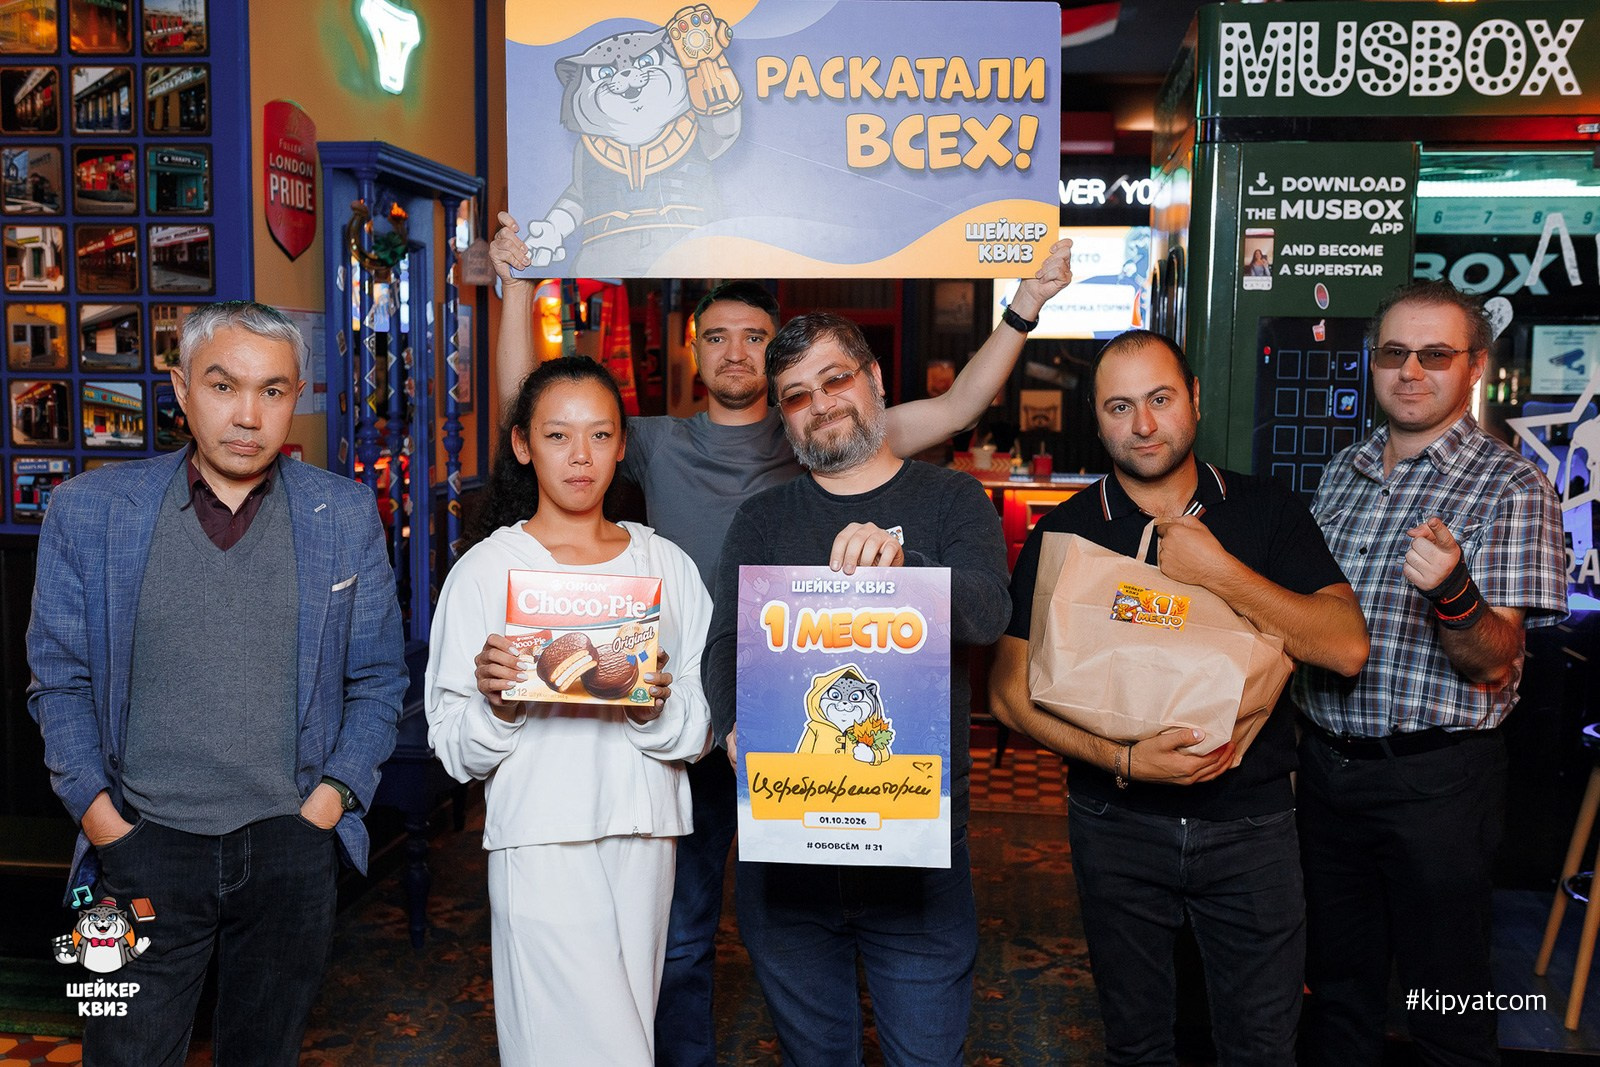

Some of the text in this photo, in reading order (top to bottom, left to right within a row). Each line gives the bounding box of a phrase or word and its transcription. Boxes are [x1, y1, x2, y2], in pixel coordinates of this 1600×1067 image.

[1218, 19, 1585, 97] MUSBOX
[756, 55, 1046, 101] РАСКАТАЛИ
[846, 113, 1039, 171] ВСЕХ!
[269, 152, 313, 177] LONDON
[269, 173, 314, 211] PRIDE
[1281, 176, 1406, 192] DOWNLOAD
[1245, 199, 1404, 220] THE MUSBOX
[1433, 210, 1444, 224] 6
[1484, 210, 1493, 224] 7
[1532, 210, 1544, 224] 8
[1582, 210, 1594, 224] 9
[965, 217, 1049, 243] ШЕЙКЕР
[1370, 222, 1404, 235] APP
[978, 243, 1034, 264] КВИЗ
[1280, 244, 1384, 257] AND BECOME
[1279, 264, 1383, 276] A SUPERSTAR
[791, 577, 896, 595] ШЕЙКЕР КВИЗ
[1154, 596, 1172, 615] 1
[762, 603, 925, 650] 1 МЕСТО
[1136, 612, 1183, 627] МЕСТО
[612, 626, 656, 653] Original
[517, 687, 528, 697] 12
[819, 816, 867, 826] 01.10.2026
